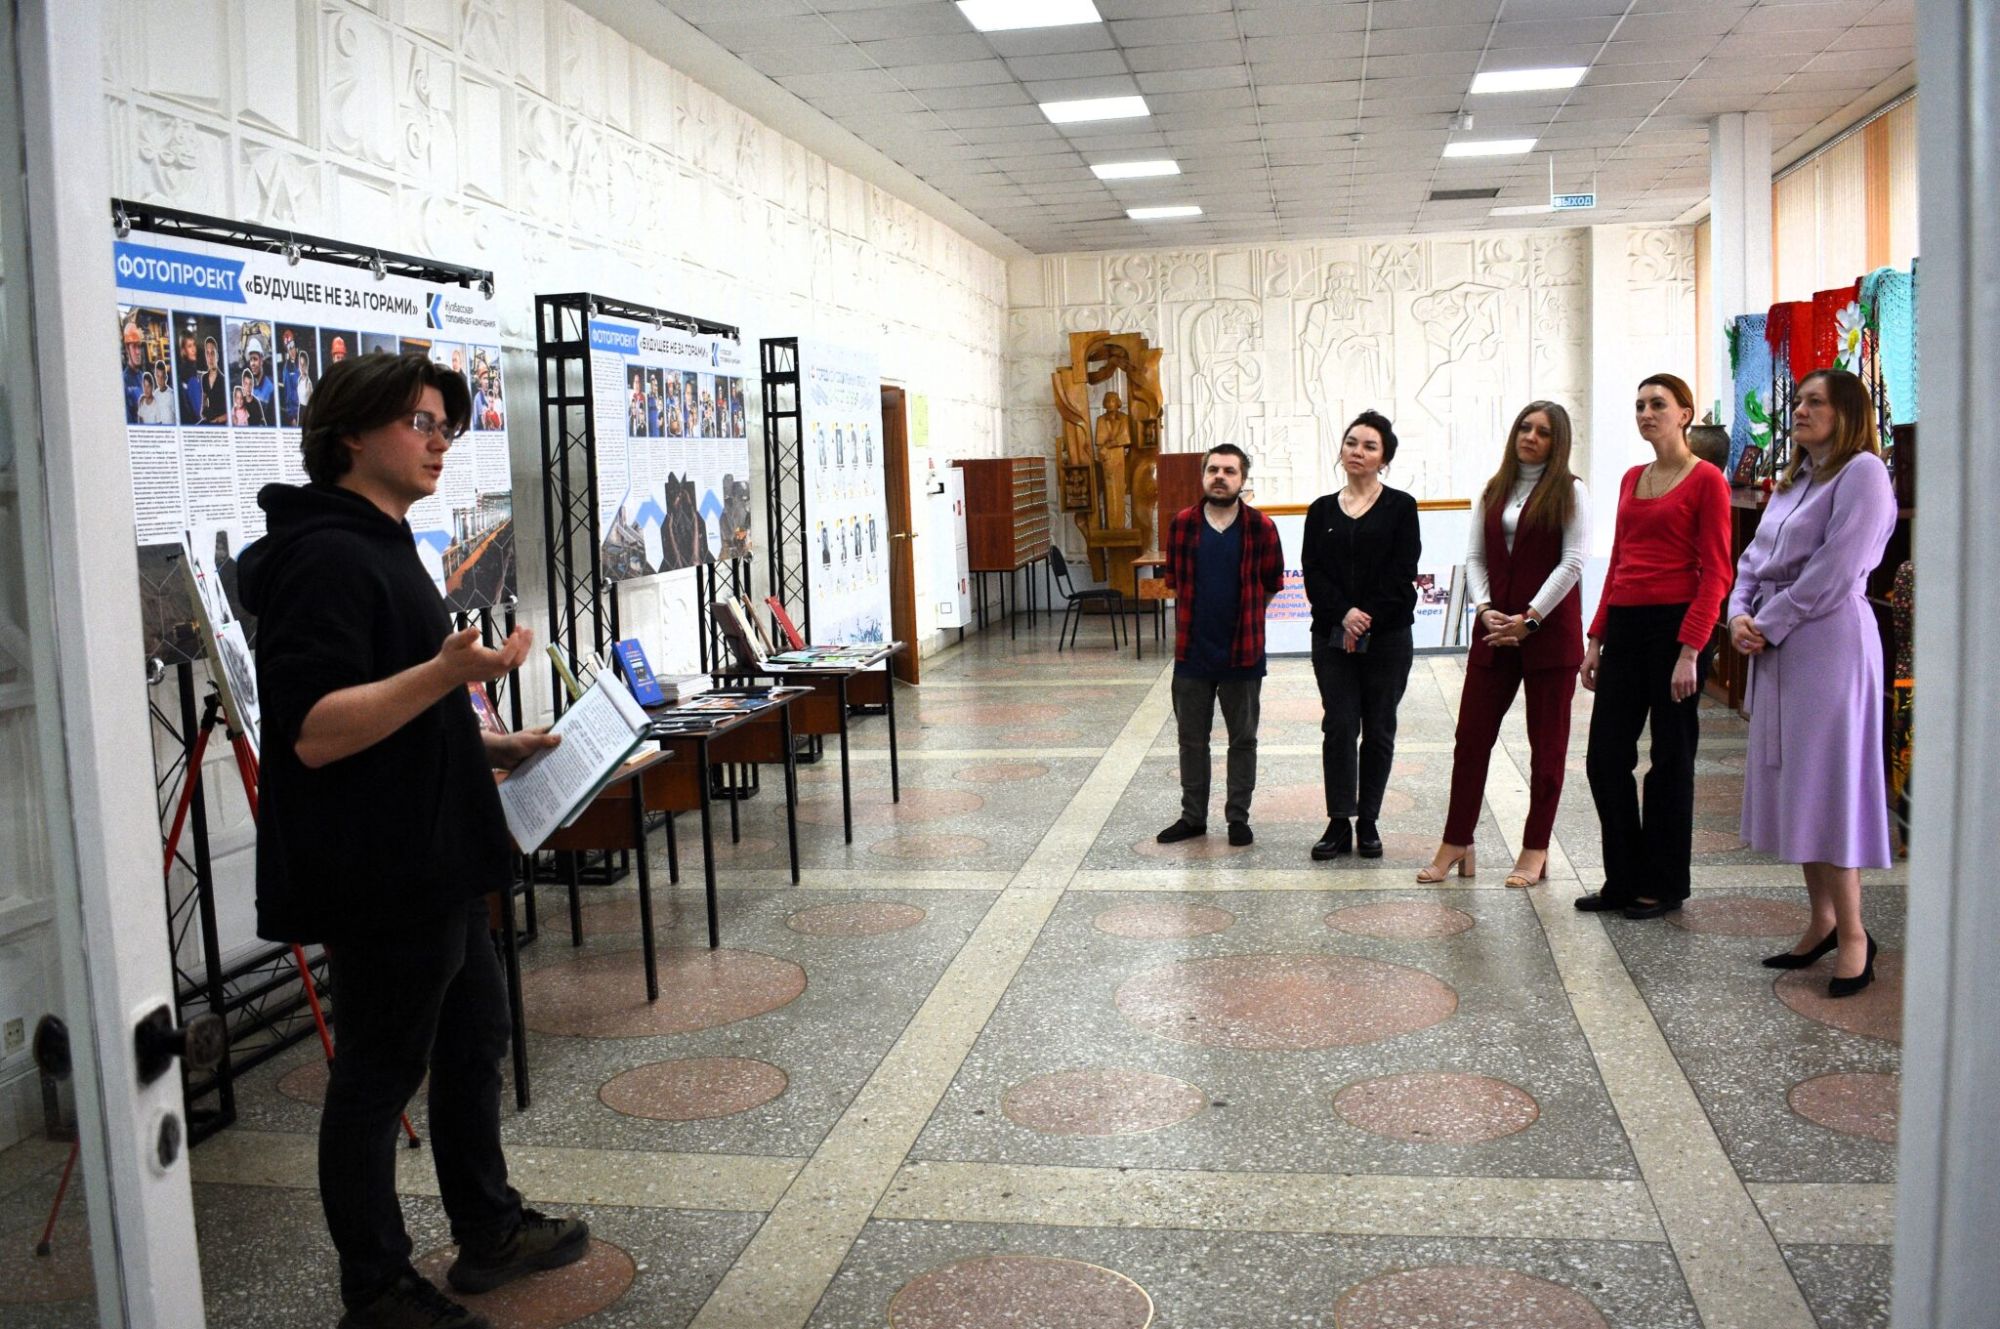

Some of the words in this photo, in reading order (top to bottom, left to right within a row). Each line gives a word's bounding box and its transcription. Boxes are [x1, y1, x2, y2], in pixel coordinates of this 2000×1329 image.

[1555, 196, 1592, 206] ВЫХОД
[117, 253, 236, 291] ФОТОПРОЕКТ
[245, 275, 322, 304] «БУДУЩЕЕ
[325, 286, 342, 306] НЕ
[344, 288, 361, 309] ЗА
[363, 292, 419, 315] ГОРАМИ»
[592, 328, 636, 348] ФОТОПРОЕКТ
[1416, 608, 1443, 616] через
